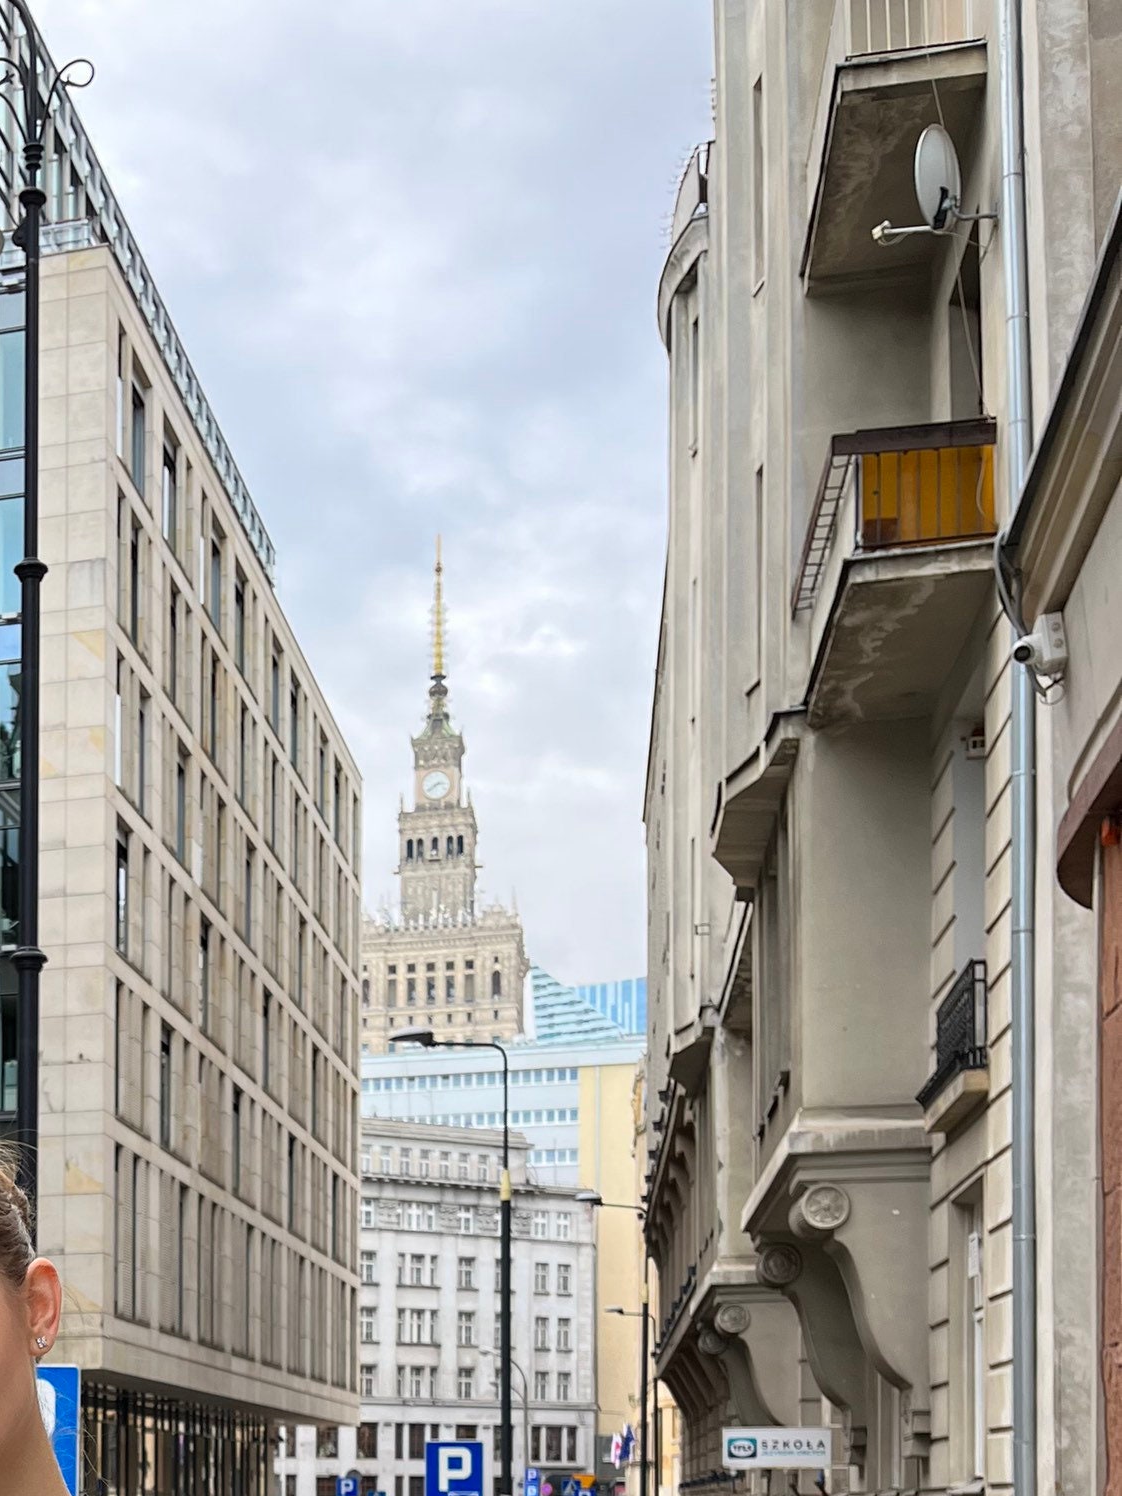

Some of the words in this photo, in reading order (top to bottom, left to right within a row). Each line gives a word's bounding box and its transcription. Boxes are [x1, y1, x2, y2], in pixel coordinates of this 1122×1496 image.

[761, 1439, 826, 1451] SZKOŁA
[438, 1447, 472, 1492] P
[340, 1479, 354, 1496] P
